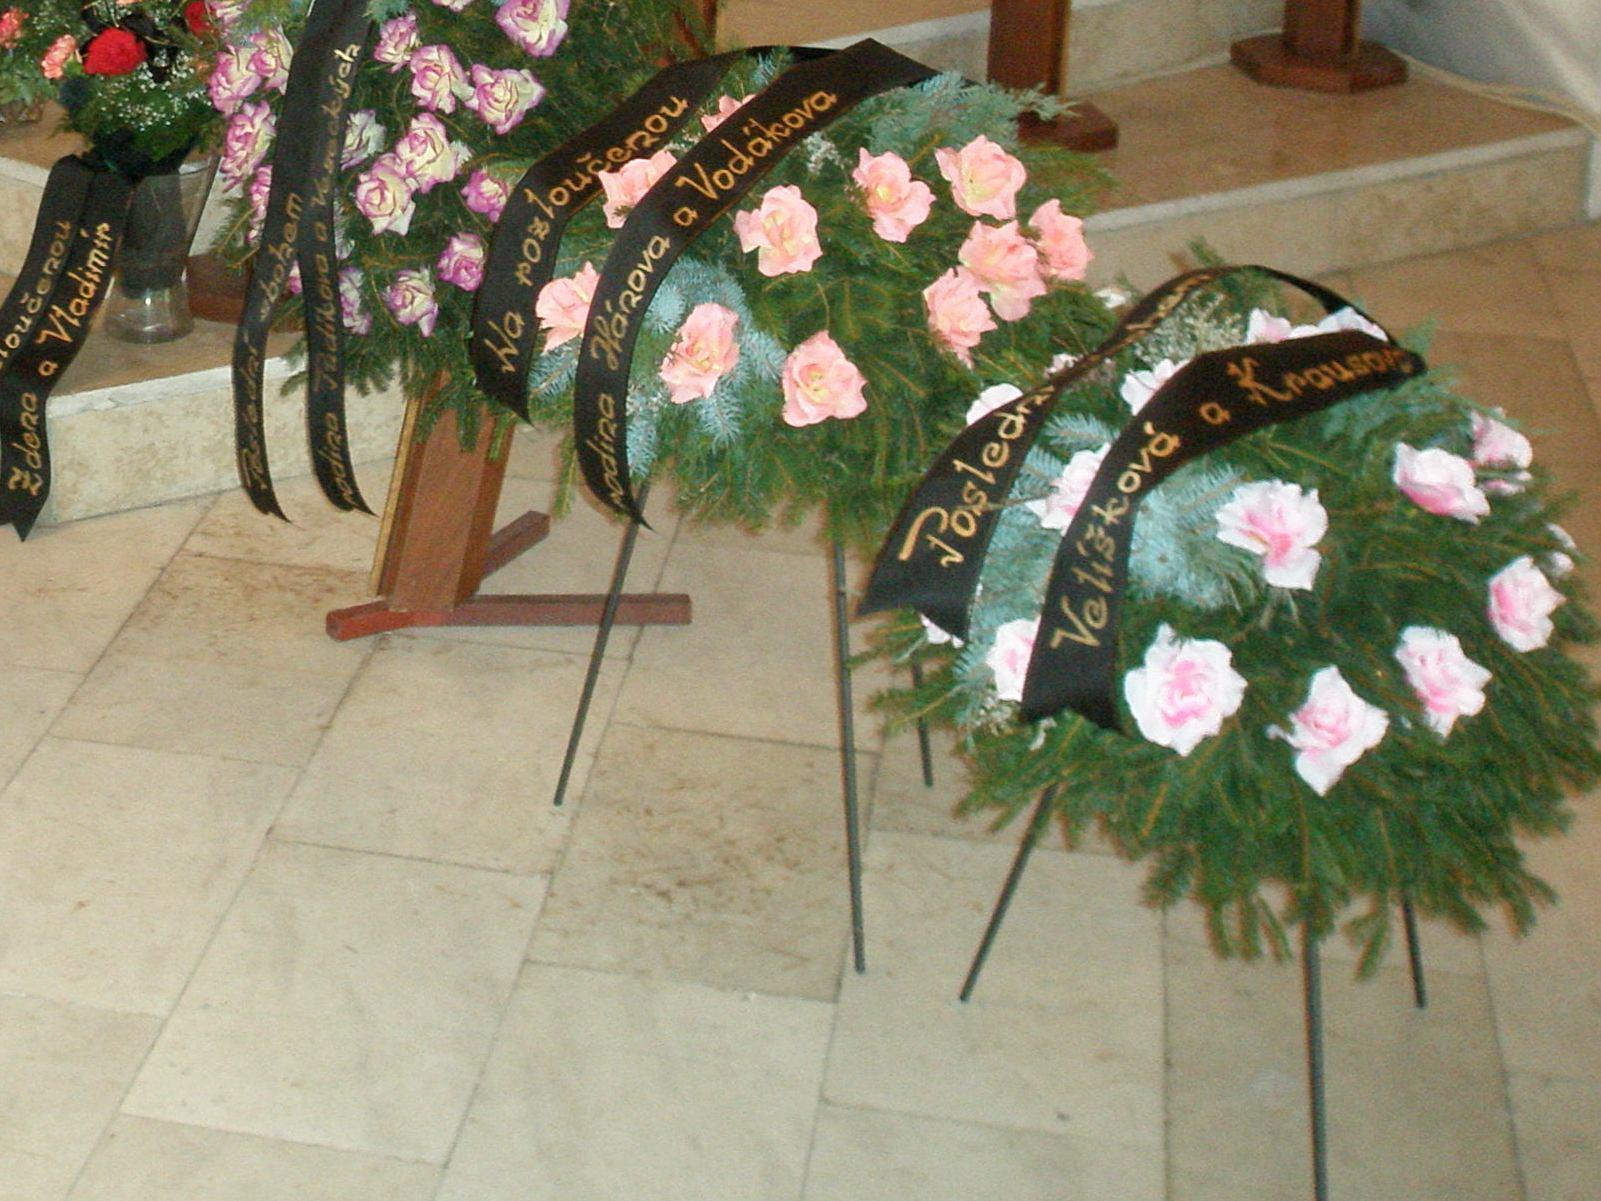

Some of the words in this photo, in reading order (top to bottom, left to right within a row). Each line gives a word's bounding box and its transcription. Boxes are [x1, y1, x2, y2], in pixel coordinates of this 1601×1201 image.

[674, 89, 838, 200] Vodákova
[314, 220, 328, 242] a
[484, 310, 526, 373] Na
[513, 95, 689, 287] rozloučenou
[672, 205, 699, 227] a
[35, 221, 114, 345] Vladimír
[37, 359, 59, 377] a
[7, 391, 44, 498] Zdena
[317, 411, 355, 506] rodina
[586, 392, 627, 505] rodina
[1049, 421, 1182, 650] Velíšková
[1198, 400, 1232, 427] a
